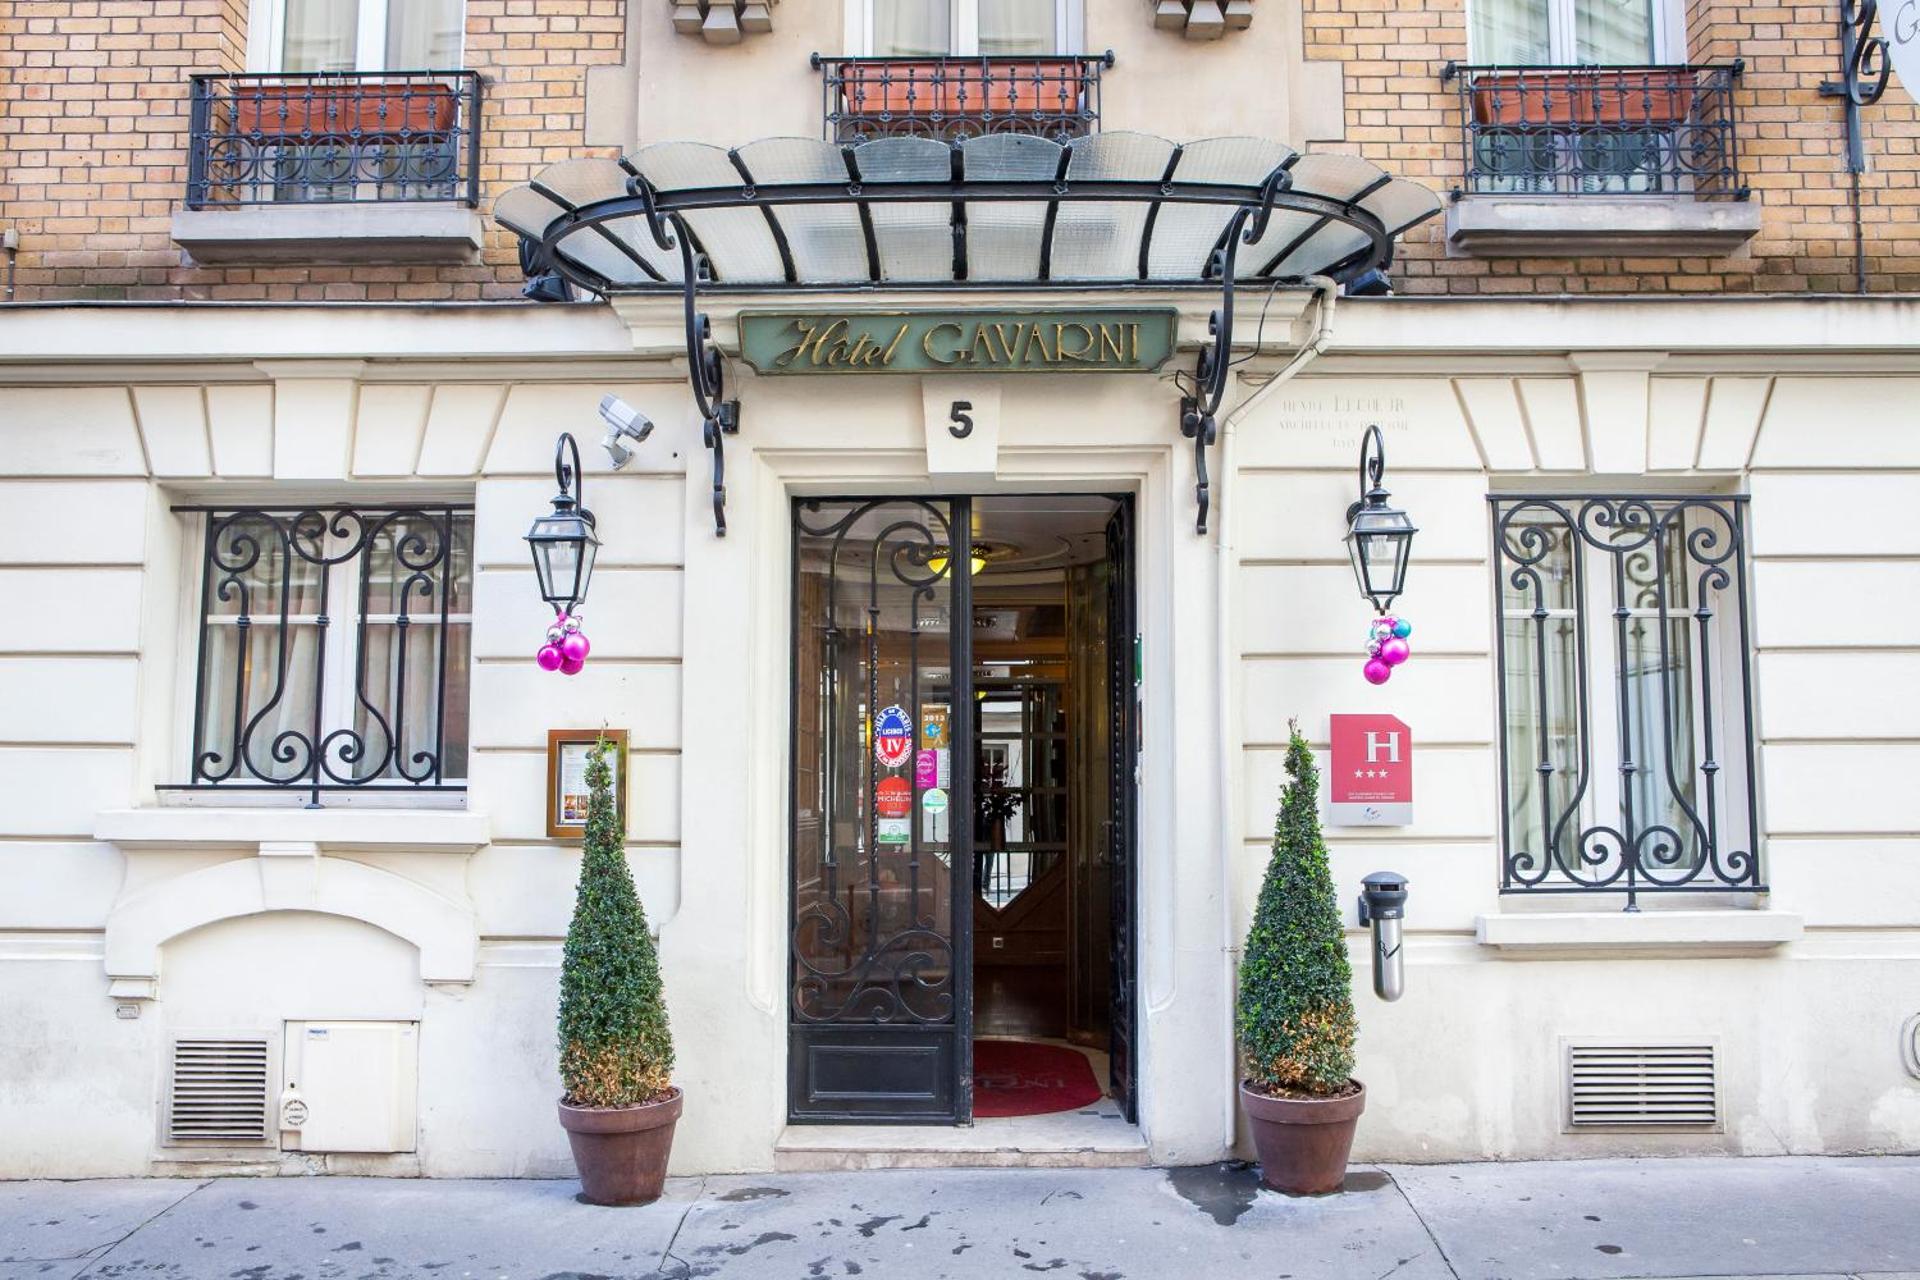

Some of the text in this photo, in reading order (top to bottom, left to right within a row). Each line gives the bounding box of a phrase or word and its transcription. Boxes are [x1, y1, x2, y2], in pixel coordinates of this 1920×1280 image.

[776, 318, 1142, 366] Hôtel GAVARNI
[948, 401, 974, 439] 5
[896, 711, 912, 732] PARIS
[887, 739, 902, 753] IV
[1363, 730, 1402, 763] H
[877, 794, 912, 802] MICHELIN
